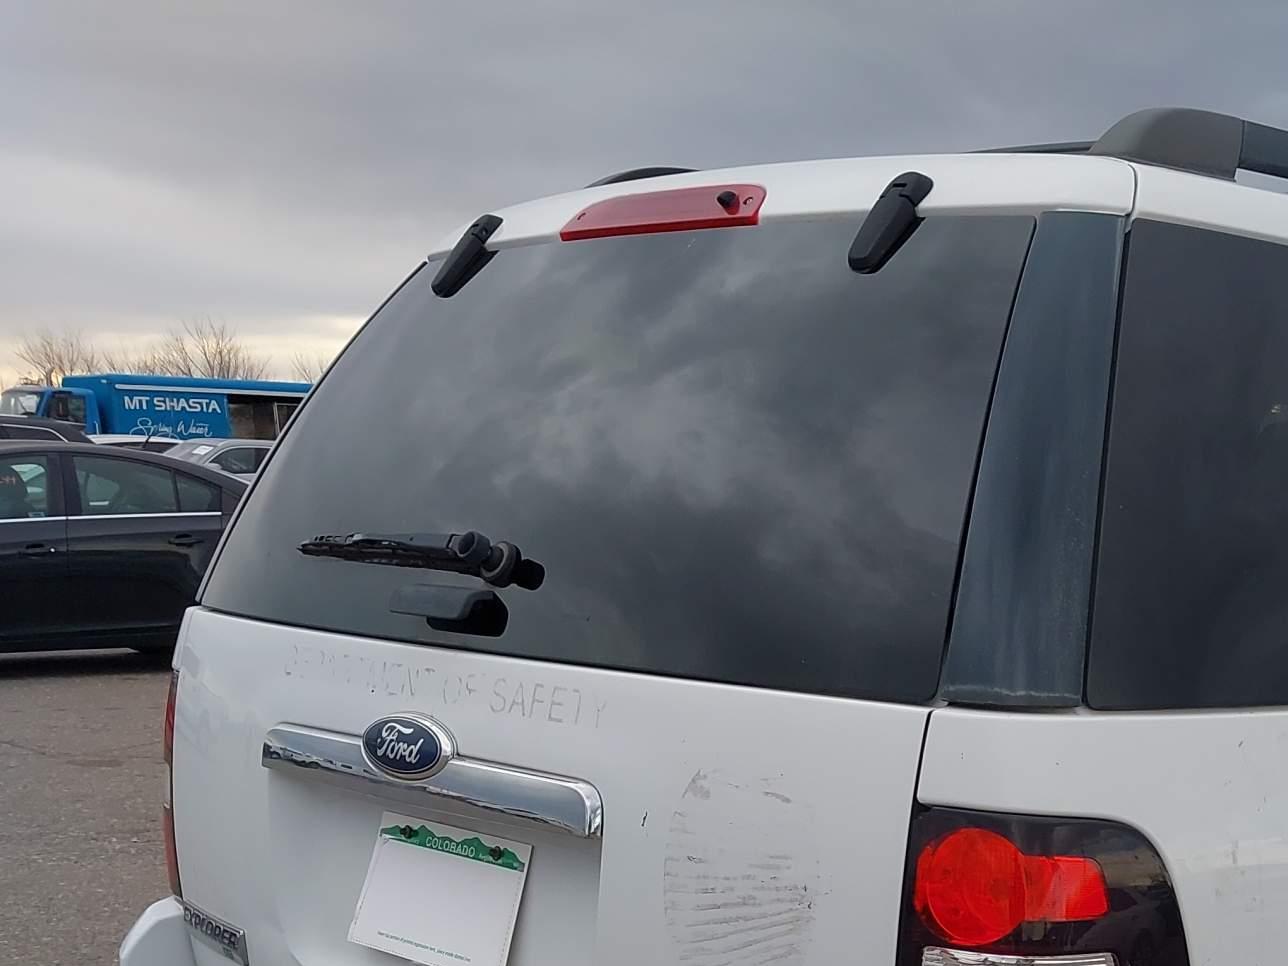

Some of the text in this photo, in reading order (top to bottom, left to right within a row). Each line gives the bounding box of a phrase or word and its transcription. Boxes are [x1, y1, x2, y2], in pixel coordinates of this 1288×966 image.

[123, 395, 222, 413] MT SHASTA
[376, 722, 424, 764] Ford
[424, 835, 477, 858] COLORADO
